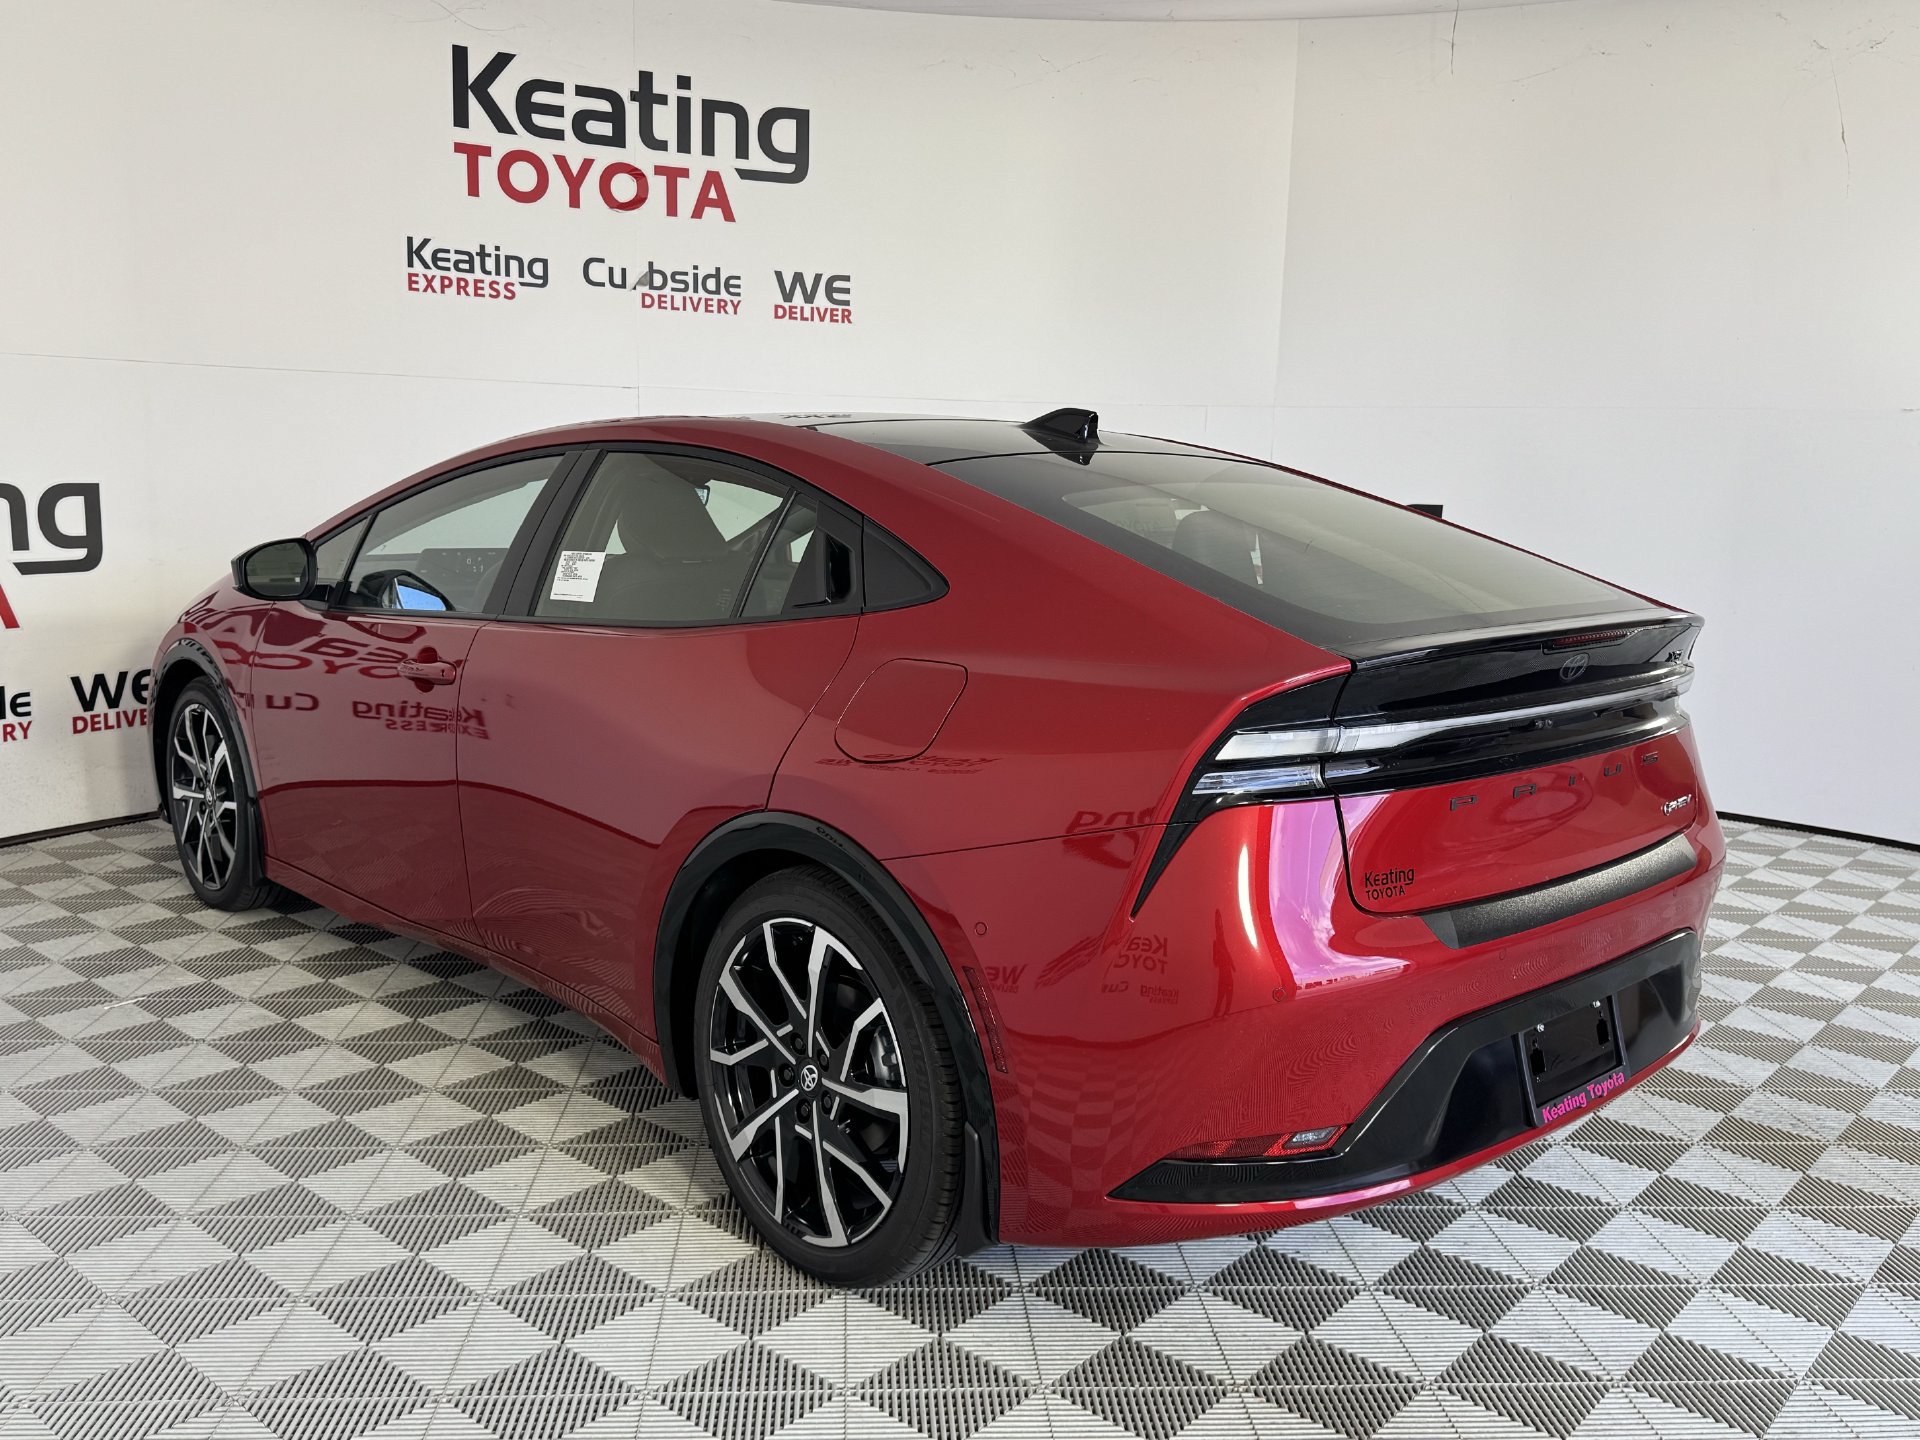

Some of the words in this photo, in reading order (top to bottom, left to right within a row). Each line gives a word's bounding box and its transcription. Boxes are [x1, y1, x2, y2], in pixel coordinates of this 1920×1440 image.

[451, 44, 811, 184] Keating
[453, 141, 737, 223] TOYOTA
[406, 235, 549, 289] Keating
[583, 257, 742, 297] Cubside
[407, 272, 517, 301] EXPRESS
[641, 292, 742, 316] DELIVERY
[774, 270, 851, 307] WE
[773, 304, 853, 325] DELIVER
[72, 708, 147, 735] DELIVE
[1450, 751, 1660, 812] PRIUS
[1364, 867, 1415, 889] Keating
[1365, 885, 1406, 901] TOYOTA
[1541, 1091, 1588, 1124] Keating
[1586, 1071, 1626, 1099] Toyota
